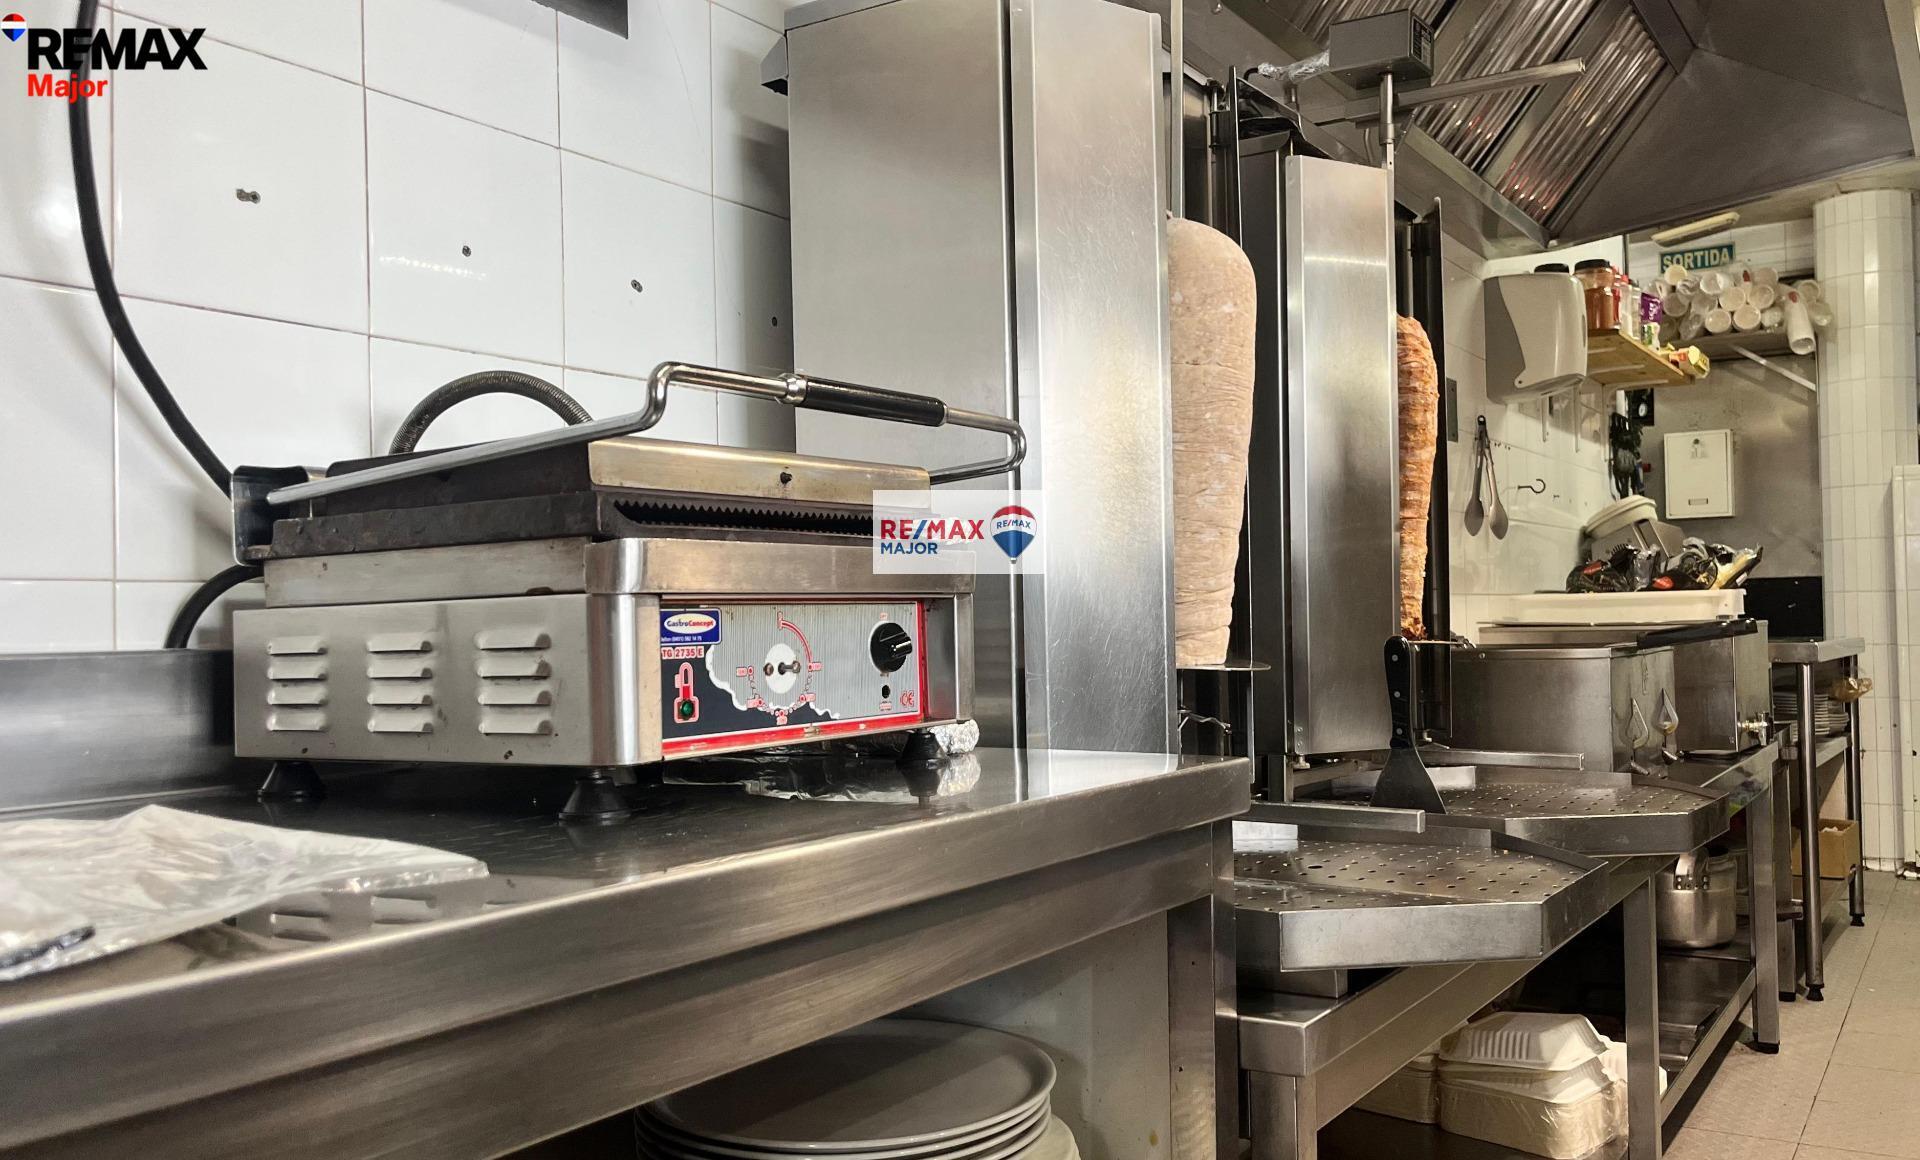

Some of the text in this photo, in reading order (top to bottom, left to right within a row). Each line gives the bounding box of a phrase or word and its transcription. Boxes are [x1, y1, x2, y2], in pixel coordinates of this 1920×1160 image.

[1662, 247, 1730, 271] SORTIDA
[662, 648, 673, 658] TG
[675, 648, 695, 657] 2735
